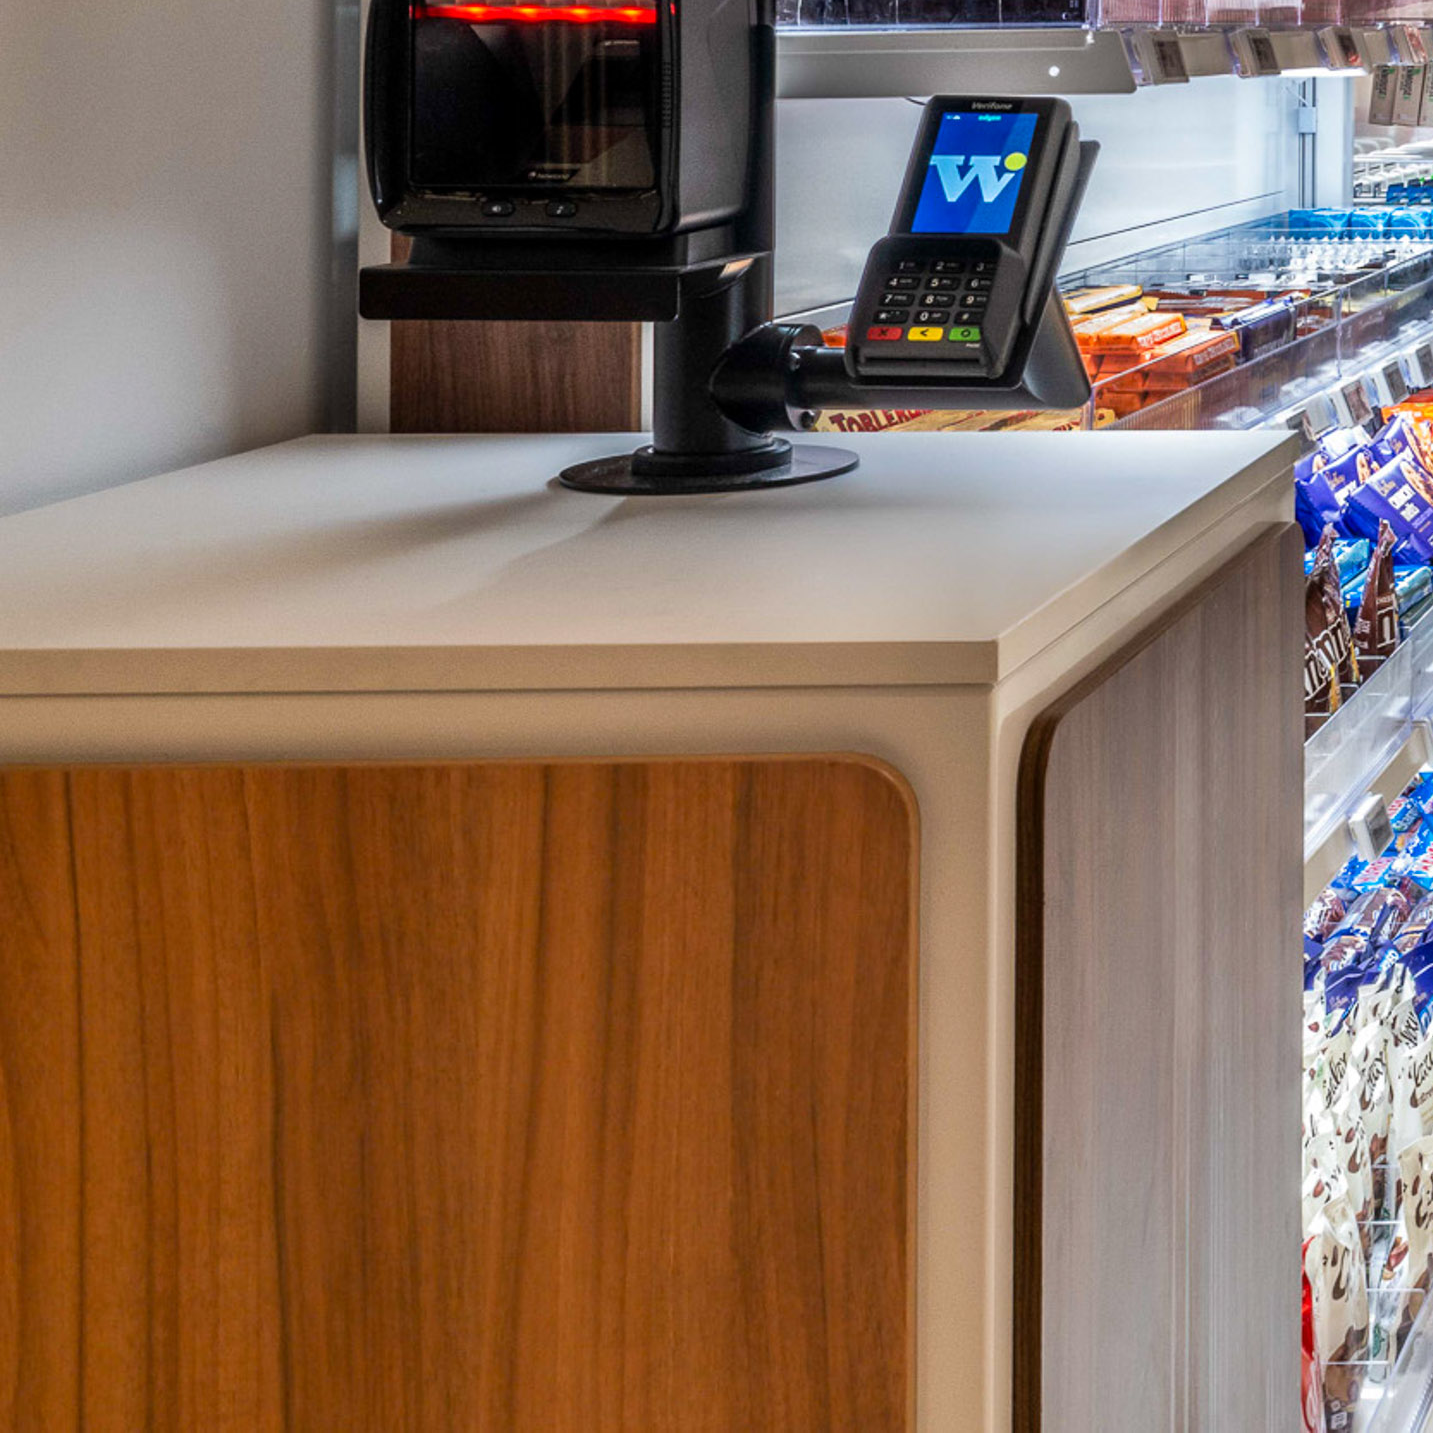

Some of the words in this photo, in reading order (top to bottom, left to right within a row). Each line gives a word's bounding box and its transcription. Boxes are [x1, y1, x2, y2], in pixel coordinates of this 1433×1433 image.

[930, 277, 939, 287] 5
[971, 278, 979, 287] 6
[884, 293, 893, 304] 7
[925, 294, 934, 304] 8
[966, 295, 975, 304] 9
